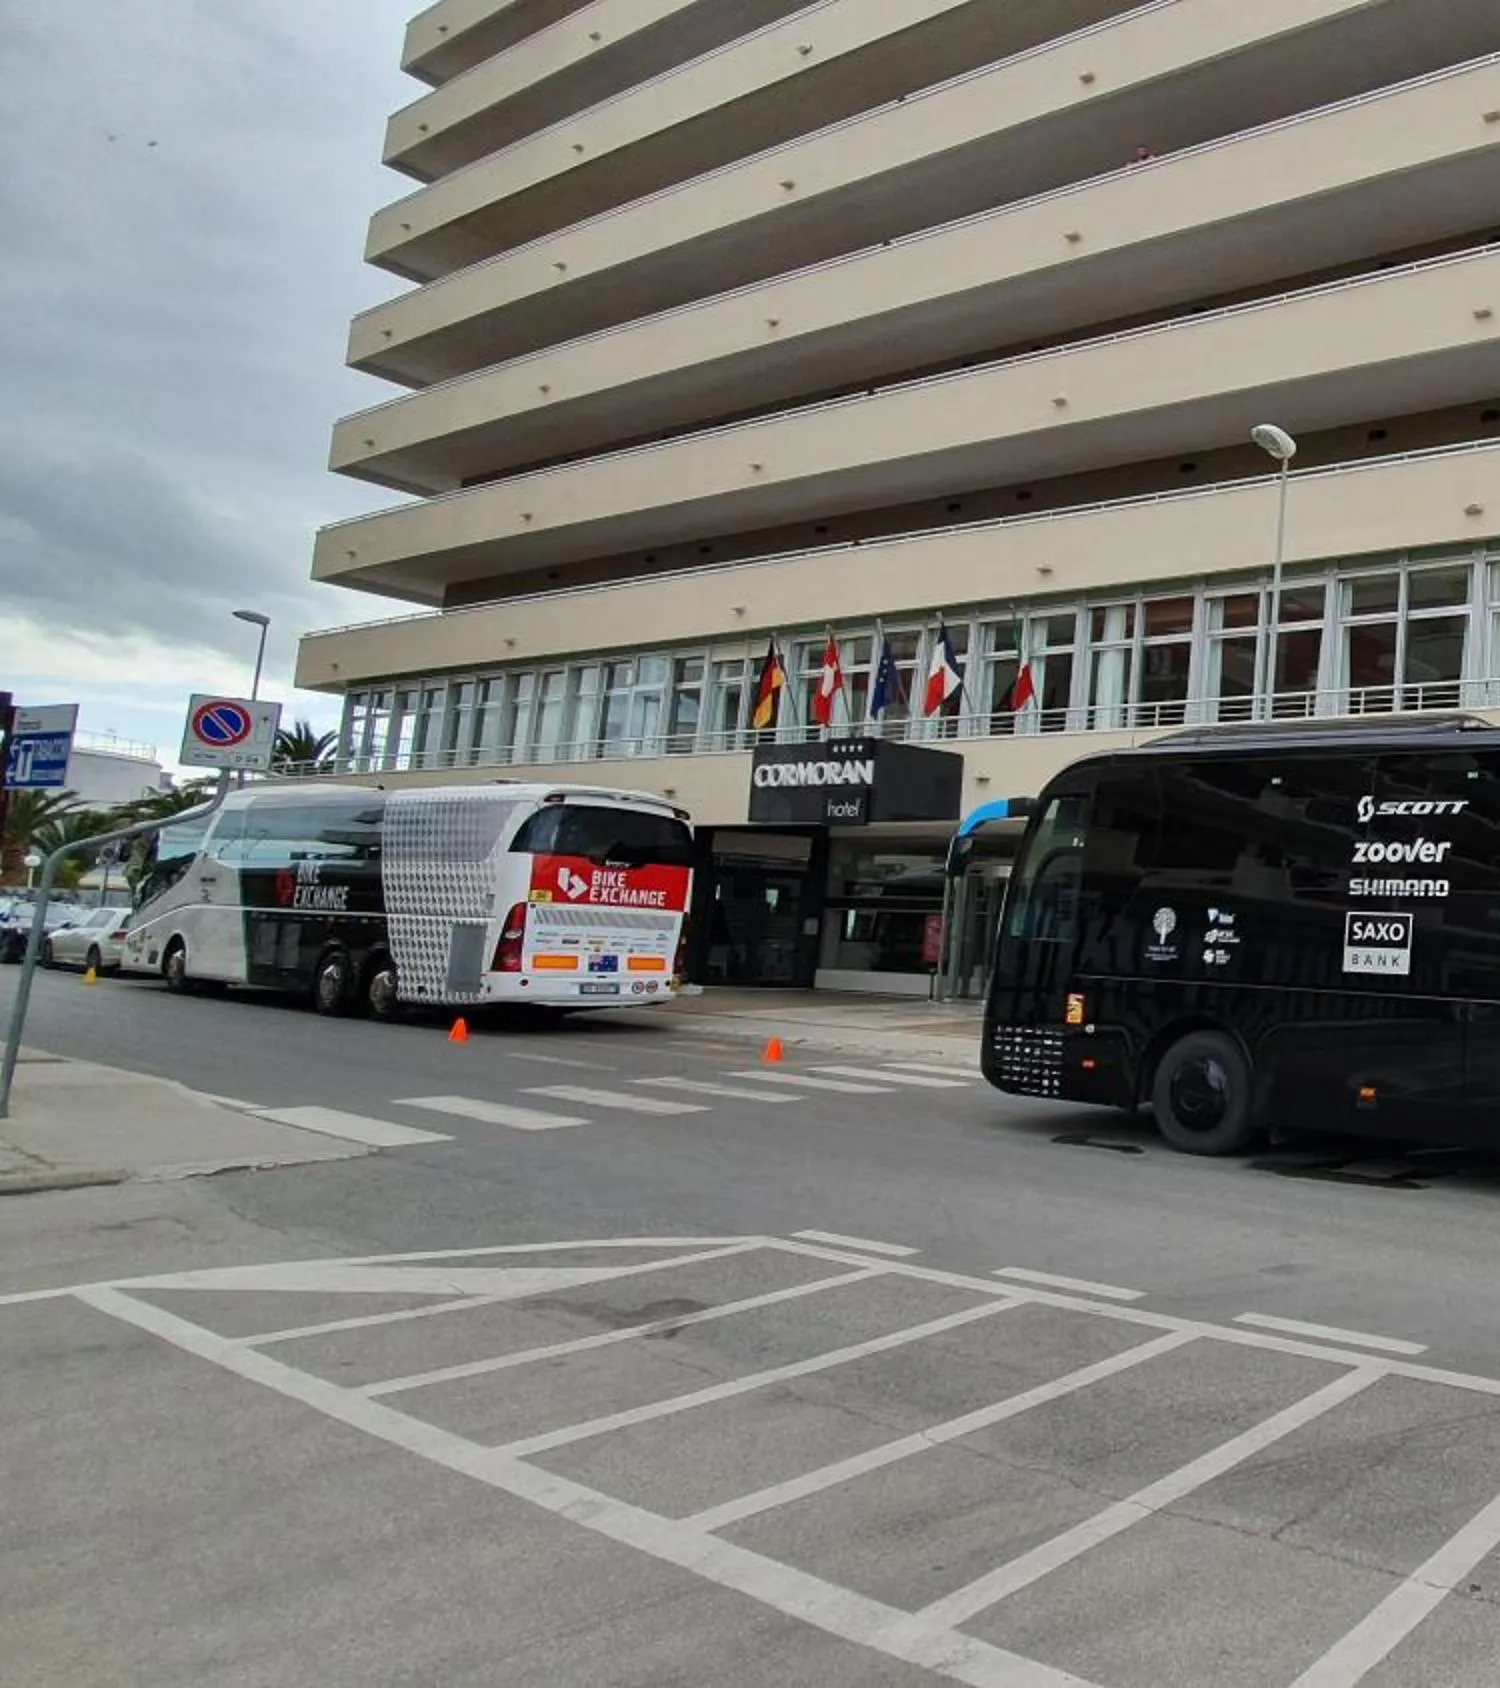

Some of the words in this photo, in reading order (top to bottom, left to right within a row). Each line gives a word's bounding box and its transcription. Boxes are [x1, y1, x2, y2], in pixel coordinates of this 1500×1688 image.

[755, 760, 874, 787] CORMORAN
[827, 798, 861, 817] hotel
[1376, 801, 1469, 815] SCOTT
[1352, 837, 1452, 863] zoover
[591, 869, 627, 886] BIKE
[589, 886, 667, 907] EXCHANGE
[1348, 878, 1450, 897] SHIMANO
[1353, 921, 1405, 942] SAXO
[1351, 954, 1401, 967] BANK
